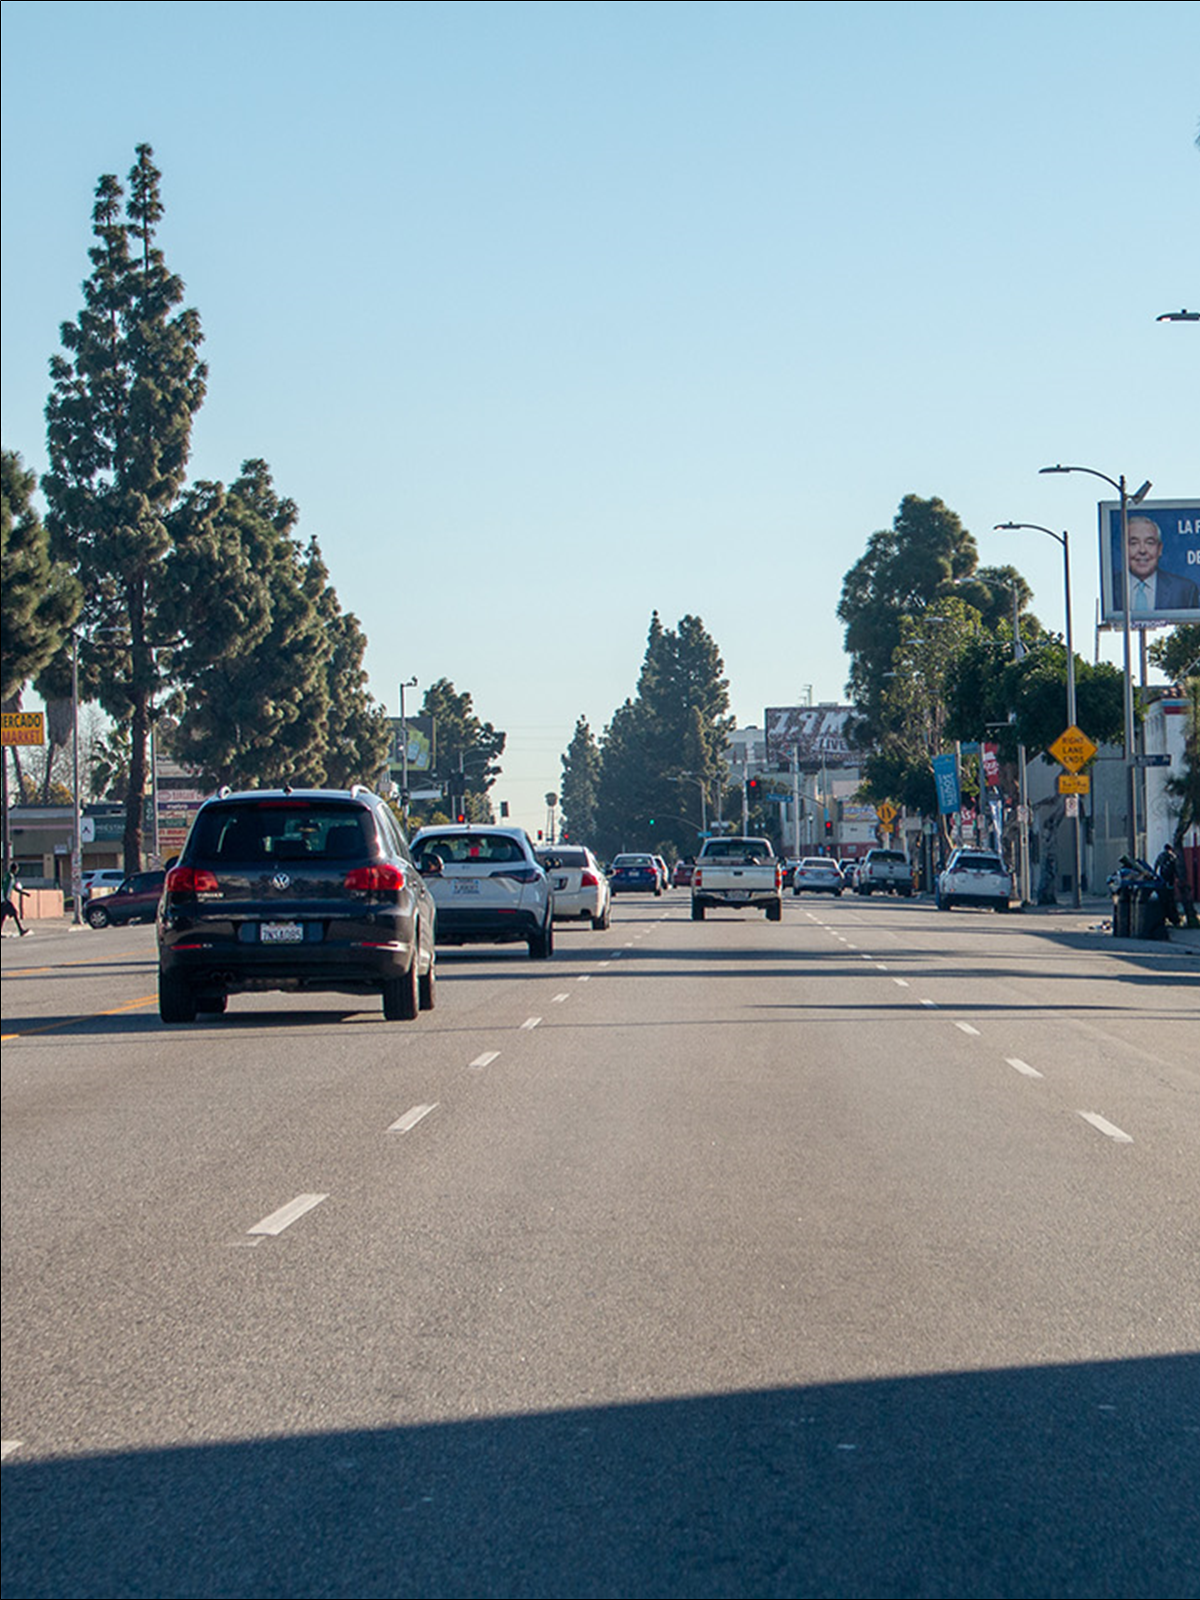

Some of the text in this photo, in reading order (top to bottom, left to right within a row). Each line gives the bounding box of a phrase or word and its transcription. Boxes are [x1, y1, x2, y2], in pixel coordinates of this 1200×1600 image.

[1178, 520, 1193, 534] LA
[1, 715, 40, 728] ERCADO
[1062, 746, 1084, 755] LANE
[1063, 755, 1084, 764] ENDS
